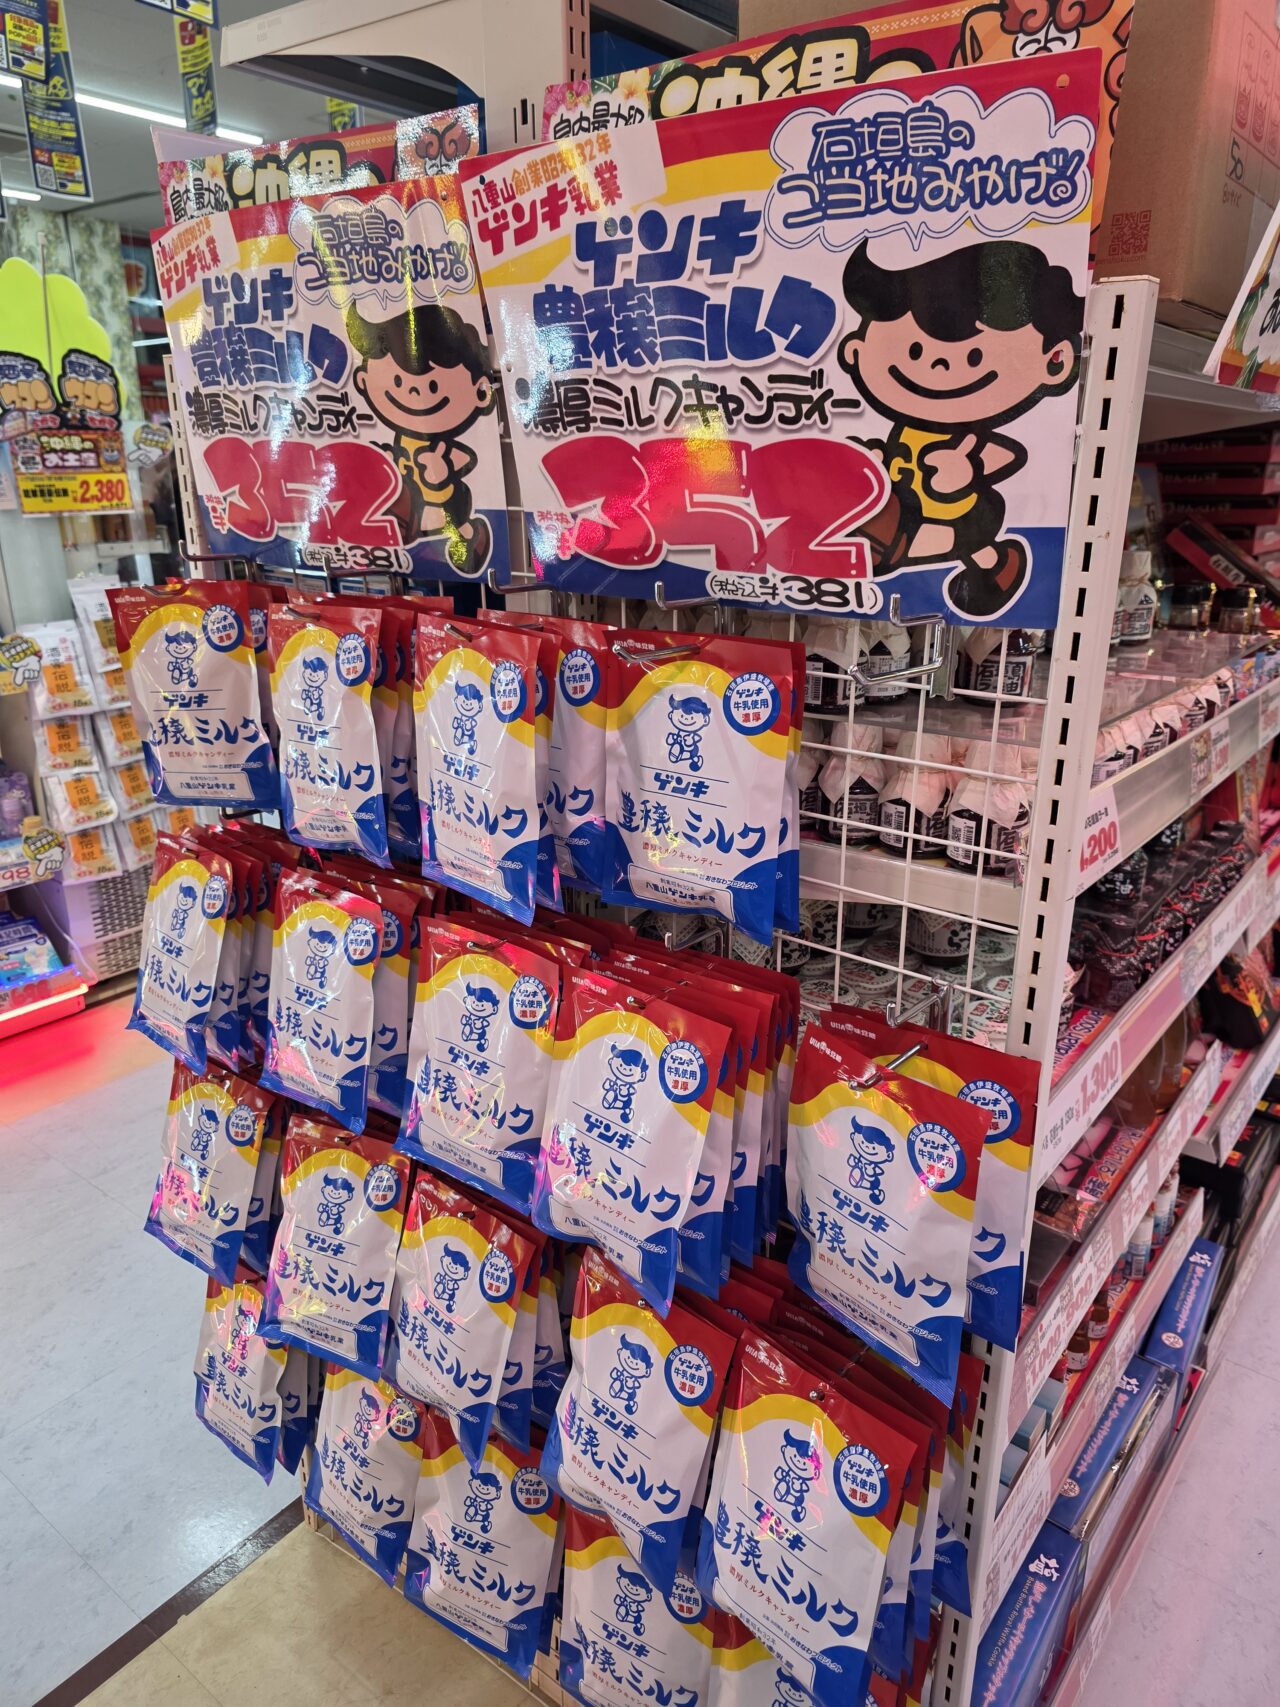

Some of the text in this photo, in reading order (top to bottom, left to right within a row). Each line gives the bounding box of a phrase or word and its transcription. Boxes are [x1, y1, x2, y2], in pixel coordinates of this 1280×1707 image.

[810, 101, 975, 167] 石垣島の
[478, 159, 622, 256] ゲンキ乳業
[312, 204, 404, 252] 石垣島の
[575, 199, 765, 287] ゲンキ
[160, 237, 221, 299] ゲンキ乳業
[202, 268, 294, 327] ゲンキ
[533, 275, 837, 368] 豊穣ミルク
[190, 323, 349, 388] 豊穣ミルク
[515, 368, 861, 433] 濃厚ミルクキャンディー
[80, 478, 125, 504] 2,380
[566, 673, 591, 684] 牛乳使用
[567, 664, 588, 674] ゲンキ
[162, 693, 209, 709] ゲンキ
[571, 685, 586, 696] 濃厚
[736, 687, 764, 698] ゲンキ
[733, 699, 769, 712] 牛乳使用
[741, 711, 762, 724] 濃厚
[443, 754, 480, 781] ゲンキ
[654, 772, 710, 798] ゲンキ
[617, 788, 767, 859] 豊穣ミルク
[160, 935, 184, 958] ゲンキ
[295, 985, 330, 1010] ゲンキ
[447, 1045, 491, 1076] ゲンキ
[666, 1066, 698, 1081] 牛乳使用
[670, 1055, 695, 1067] ゲンキ
[671, 1079, 690, 1092] 濃厚
[970, 1096, 1002, 1108] ゲンキ
[583, 1113, 635, 1151] ゲンキ
[919, 1136, 951, 1153] ゲンキ
[917, 1148, 955, 1170] 牛乳使用
[926, 1164, 946, 1180] 濃厚
[832, 1189, 890, 1234] ゲンキ
[305, 1232, 347, 1258] ゲンキ
[799, 1188, 952, 1309] 豊穣ミルク
[274, 1244, 385, 1307] 豊穣ミルク
[484, 1269, 509, 1287] 牛乳使用
[817, 1251, 903, 1311] 濃厚ミルクキャンディー
[422, 1300, 458, 1336] ゲンキ
[397, 1294, 493, 1399] 豊穣ミルク
[673, 1367, 706, 1387] 牛乳使用
[678, 1357, 704, 1373] ゲンキ
[678, 1381, 697, 1396] 濃厚
[591, 1397, 640, 1441] ゲンキ
[342, 1435, 371, 1470] ゲンキ
[560, 1391, 682, 1515] 豊穣ミルク
[319, 1431, 406, 1519] 豊穣ミルク
[847, 1458, 875, 1478] ゲンキ
[517, 1486, 547, 1498] 牛乳使用
[521, 1477, 544, 1488] ゲンキ
[571, 1454, 641, 1511] 濃厚ミルクキャンディー
[842, 1471, 878, 1495] 牛乳使用
[848, 1486, 869, 1505] 濃厚
[524, 1496, 541, 1507] 濃厚
[450, 1525, 496, 1556] ゲンキ
[715, 1496, 859, 1638] 豊穣ミルク
[1028, 1553, 1061, 1582] 塩
[669, 1591, 701, 1608] 牛乳使用
[672, 1581, 697, 1595] ゲンキ
[729, 1564, 811, 1635] 濃厚ミルクキャンディー
[677, 1602, 695, 1616] 濃厚
[601, 1622, 651, 1659] ゲンキ
